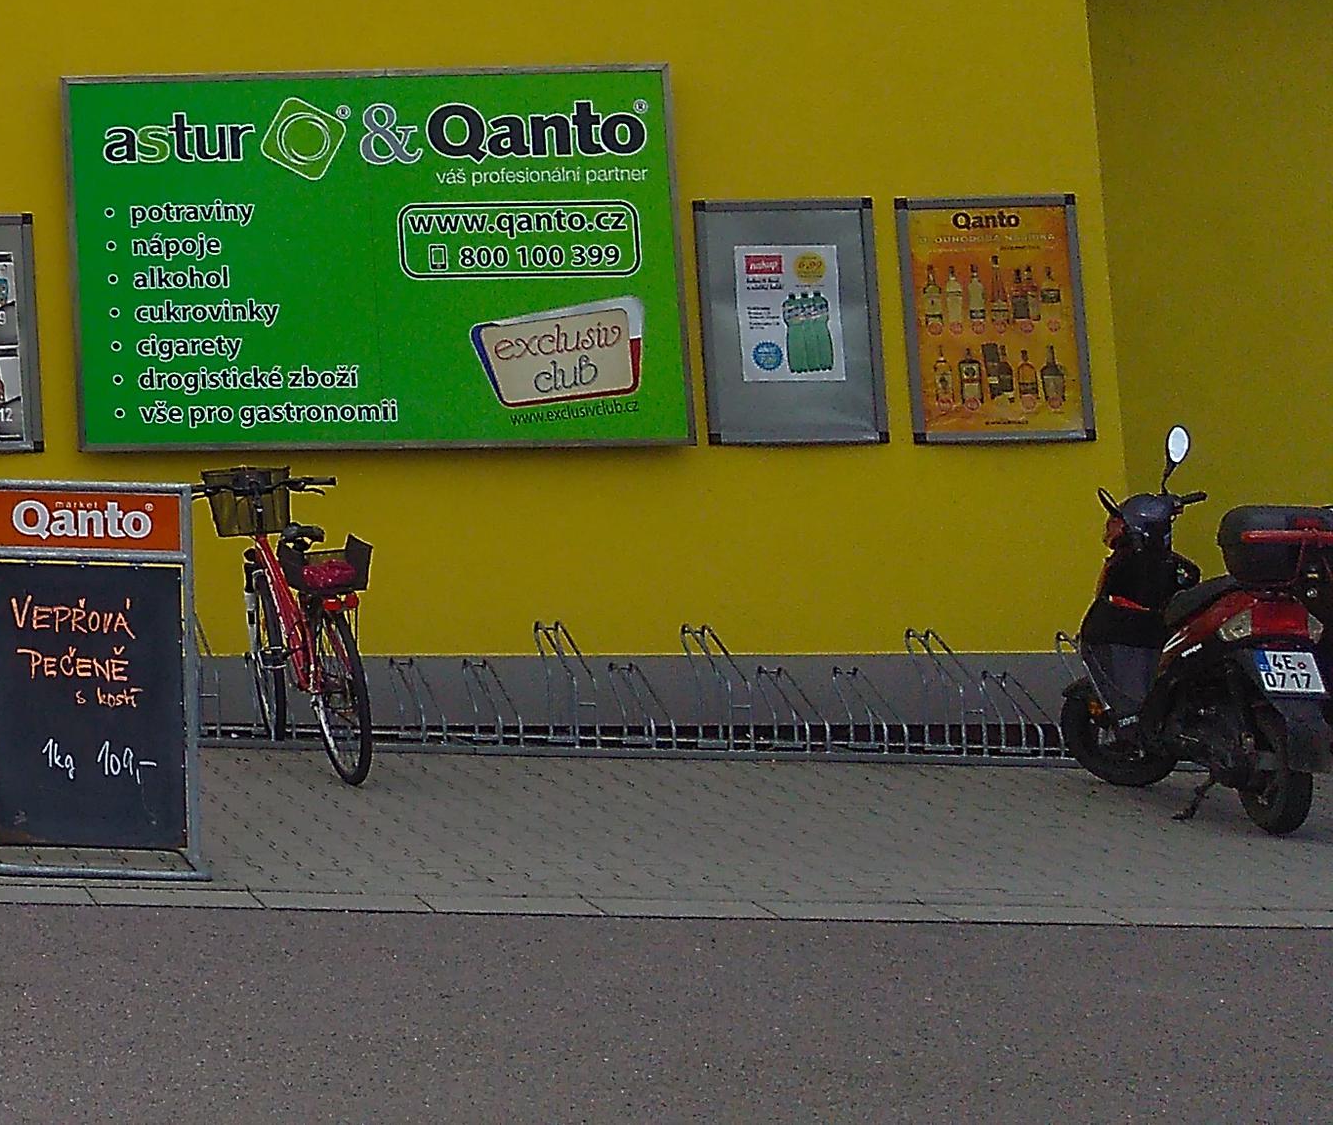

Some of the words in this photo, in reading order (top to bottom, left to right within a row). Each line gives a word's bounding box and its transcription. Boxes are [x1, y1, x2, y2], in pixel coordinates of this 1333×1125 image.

[103, 112, 254, 163] astur
[360, 103, 423, 166] &
[426, 100, 646, 165] Qanto
[437, 168, 469, 185] váš
[471, 167, 582, 188] profesionální
[586, 166, 649, 185] partner
[130, 200, 255, 226] potraviny
[409, 210, 629, 238] www.qanto.cz
[952, 210, 1021, 231] Qanto
[132, 233, 222, 260] nápoje
[459, 245, 510, 268] 800
[516, 244, 566, 268] 100
[571, 244, 621, 268] 399
[133, 266, 231, 290] alkohol
[135, 299, 280, 326] cukrovinky
[137, 333, 243, 360] cigarety
[494, 322, 623, 362] exclusiv
[138, 366, 283, 392] drogistické
[288, 366, 359, 392] zboží
[533, 359, 599, 396] club
[139, 401, 184, 426] vše
[188, 404, 235, 428] pro
[239, 399, 399, 428] gastronomii
[12, 499, 152, 540] Qanto
[10, 595, 137, 639] VEPŘOVÁ
[16, 645, 130, 682] PEČENĚ
[1272, 654, 1297, 670] 4E
[1264, 672, 1312, 689] 0717
